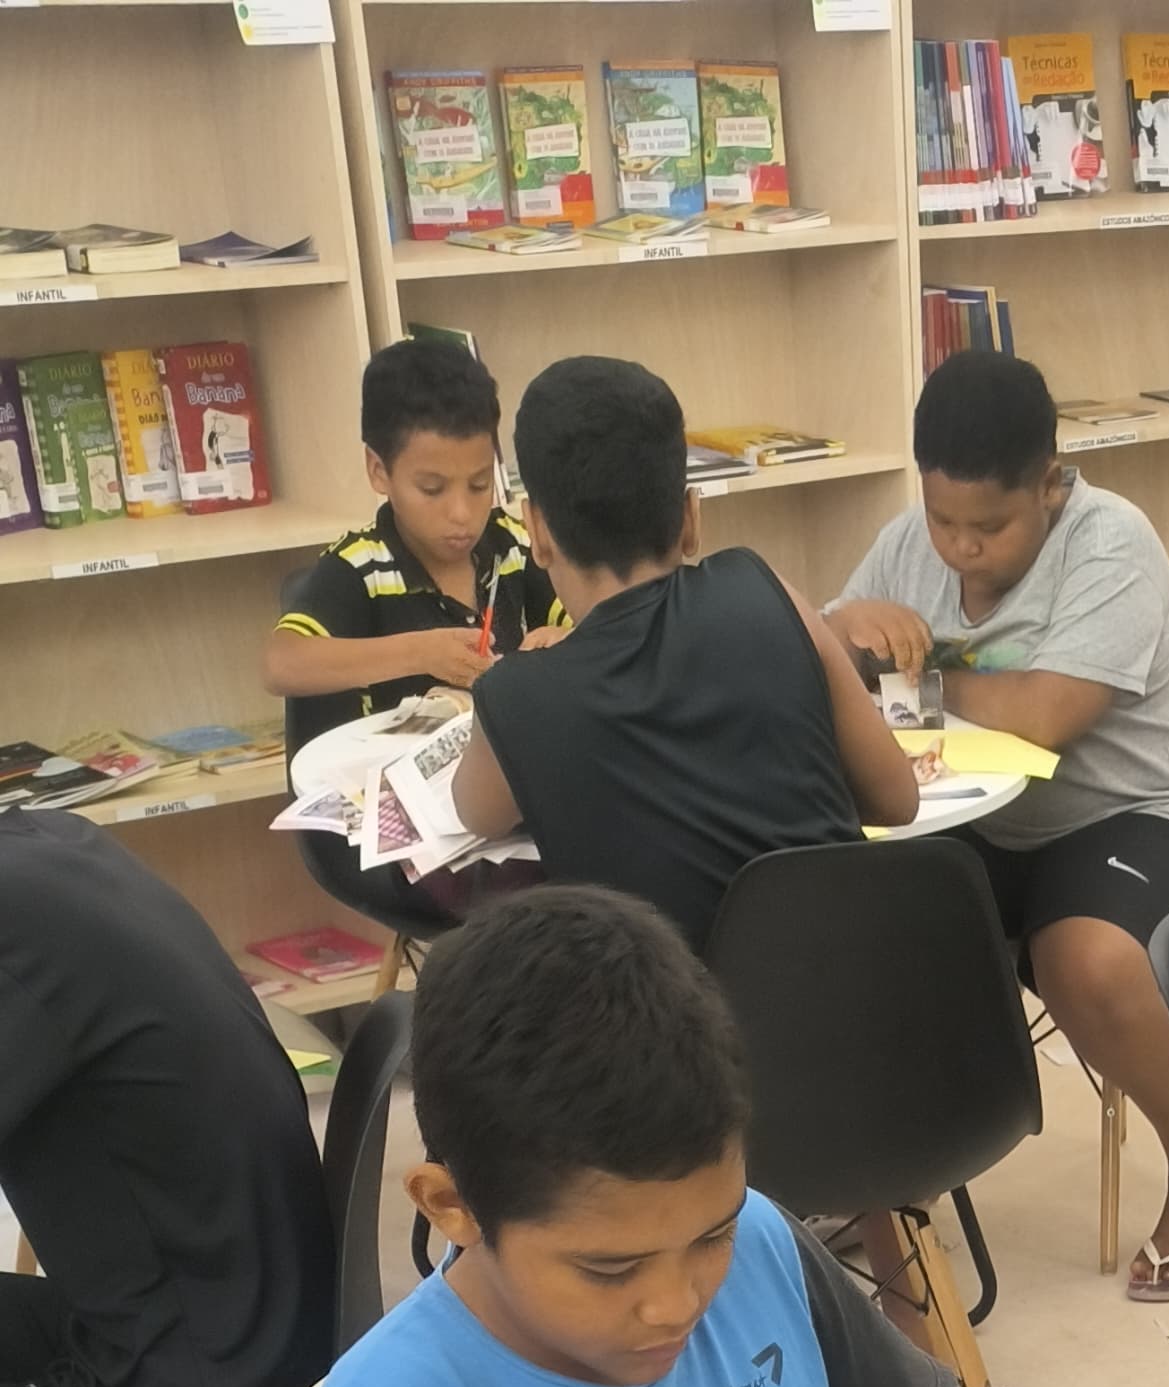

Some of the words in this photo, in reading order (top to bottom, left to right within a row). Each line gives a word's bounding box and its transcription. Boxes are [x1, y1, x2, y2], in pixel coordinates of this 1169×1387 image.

[644, 247, 683, 258] INFANTIL
[16, 288, 67, 302] INFANTIL
[131, 389, 164, 408] Ban
[186, 382, 246, 405] Banana
[82, 558, 130, 574] INFANTIL
[144, 800, 190, 817] INFANTIL
